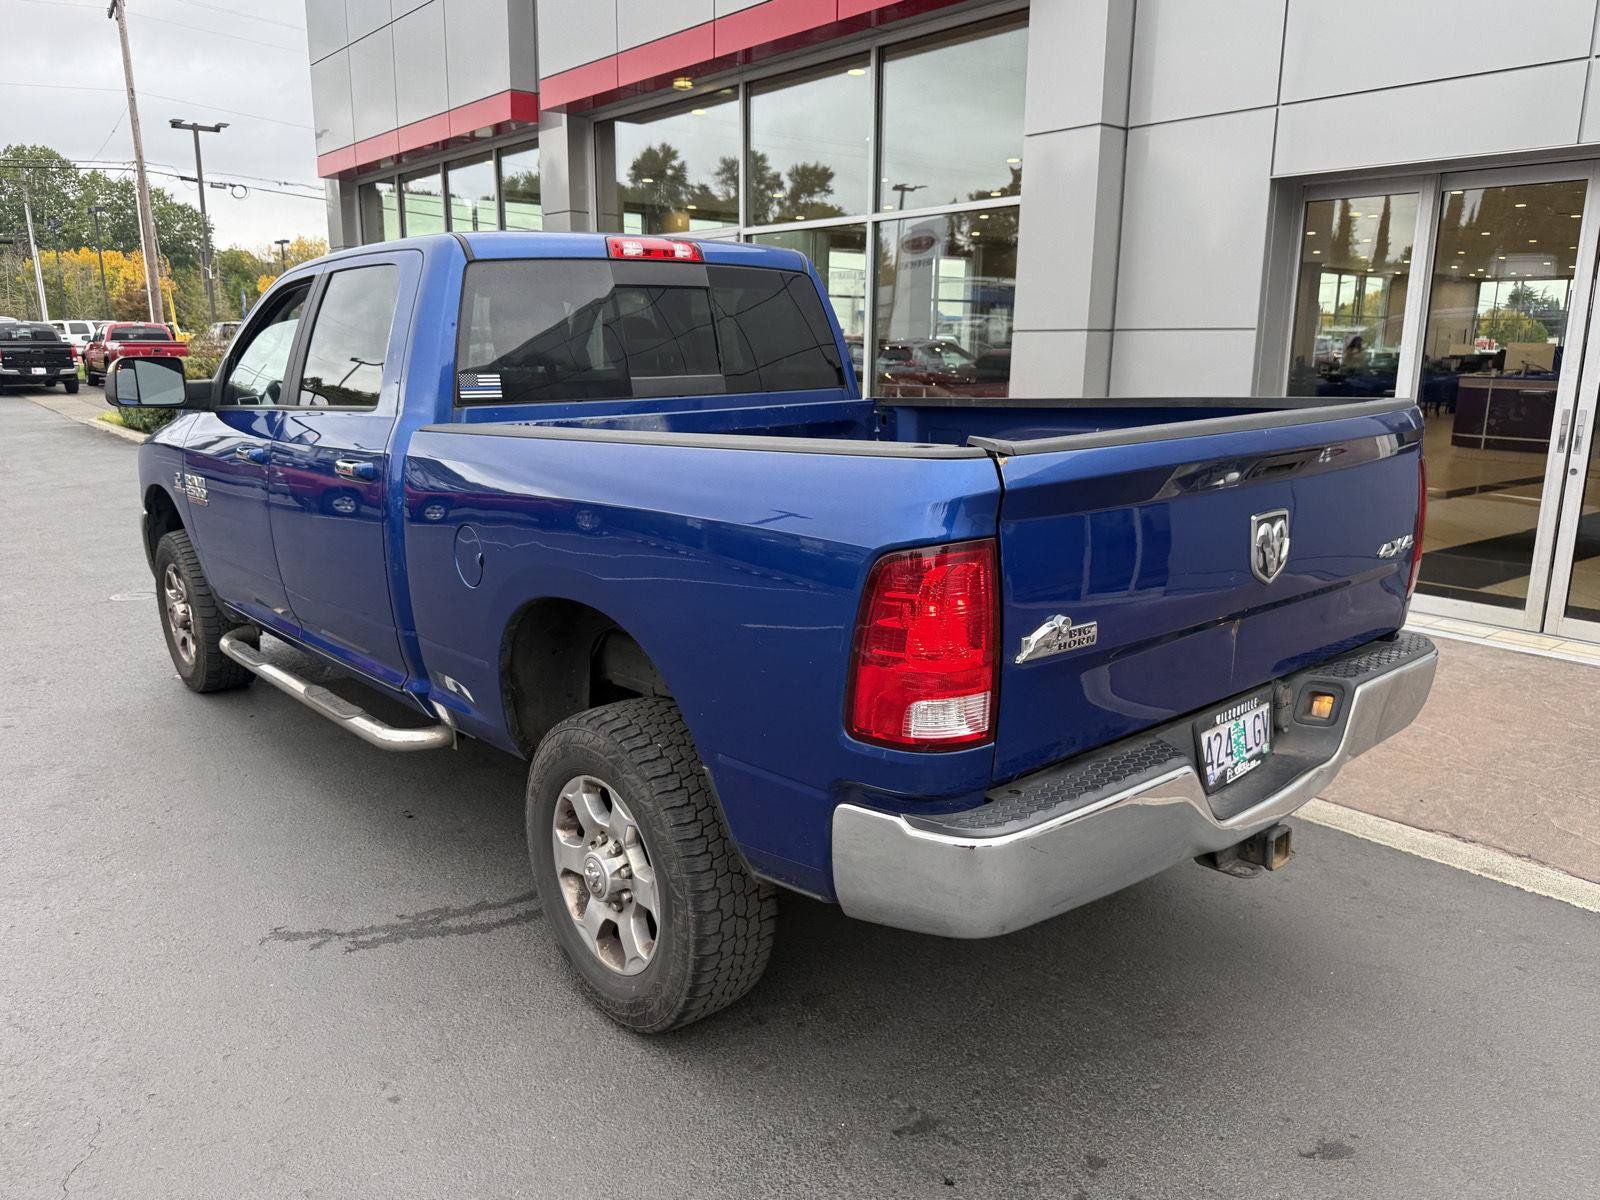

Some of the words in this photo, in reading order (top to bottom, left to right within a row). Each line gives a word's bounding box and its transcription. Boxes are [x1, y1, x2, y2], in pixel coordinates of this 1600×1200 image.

[1068, 625, 1092, 638] BIG
[1058, 635, 1096, 650] HORN
[1215, 697, 1259, 724] WILSONVILLE
